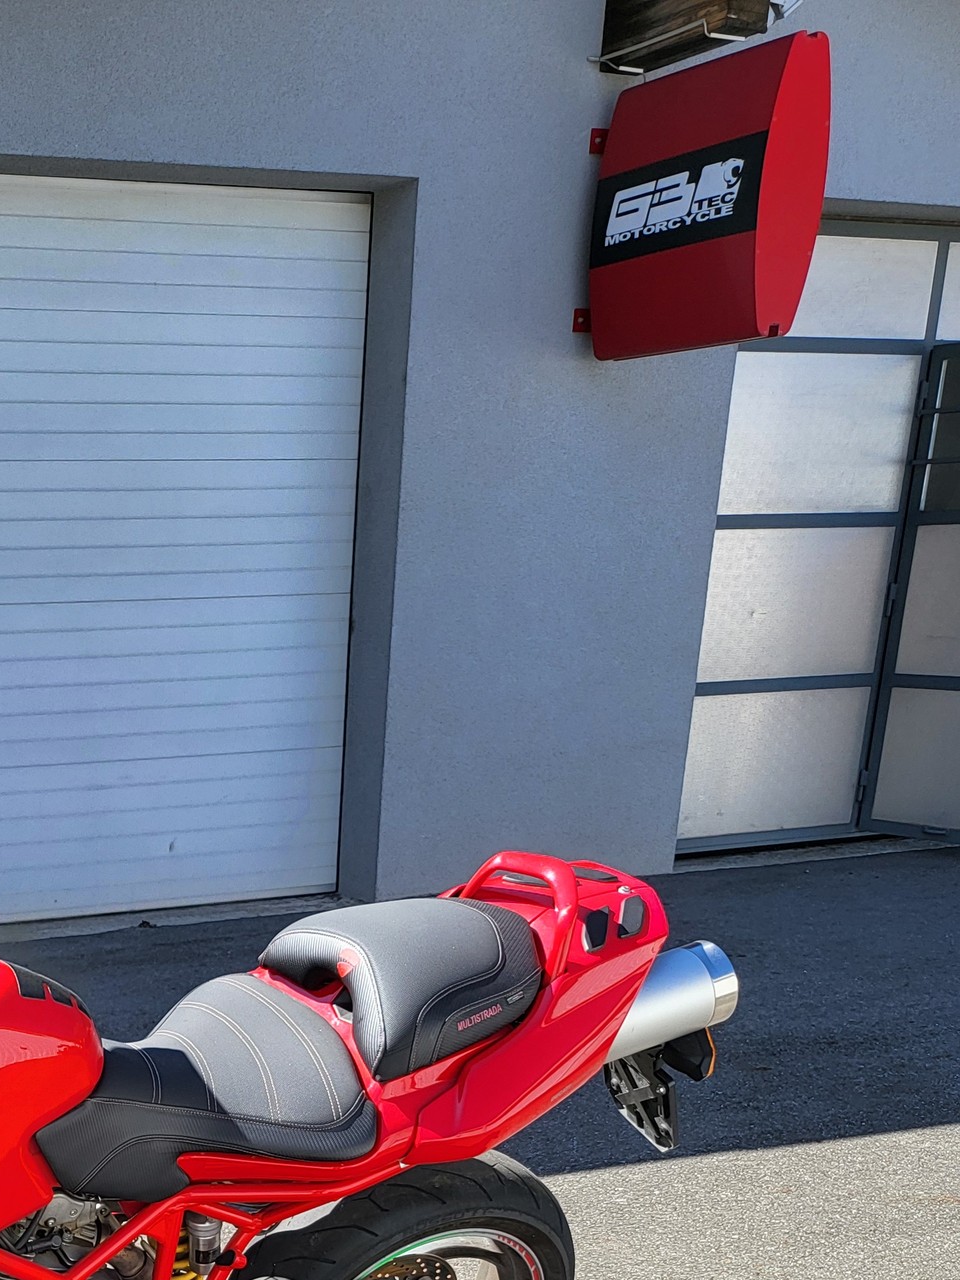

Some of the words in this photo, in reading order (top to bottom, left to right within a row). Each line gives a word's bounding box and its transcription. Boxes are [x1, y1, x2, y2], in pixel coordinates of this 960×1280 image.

[693, 191, 736, 211] TEC
[604, 203, 734, 247] MOTORCYCLE
[457, 1003, 503, 1032] MULTISTRADA
